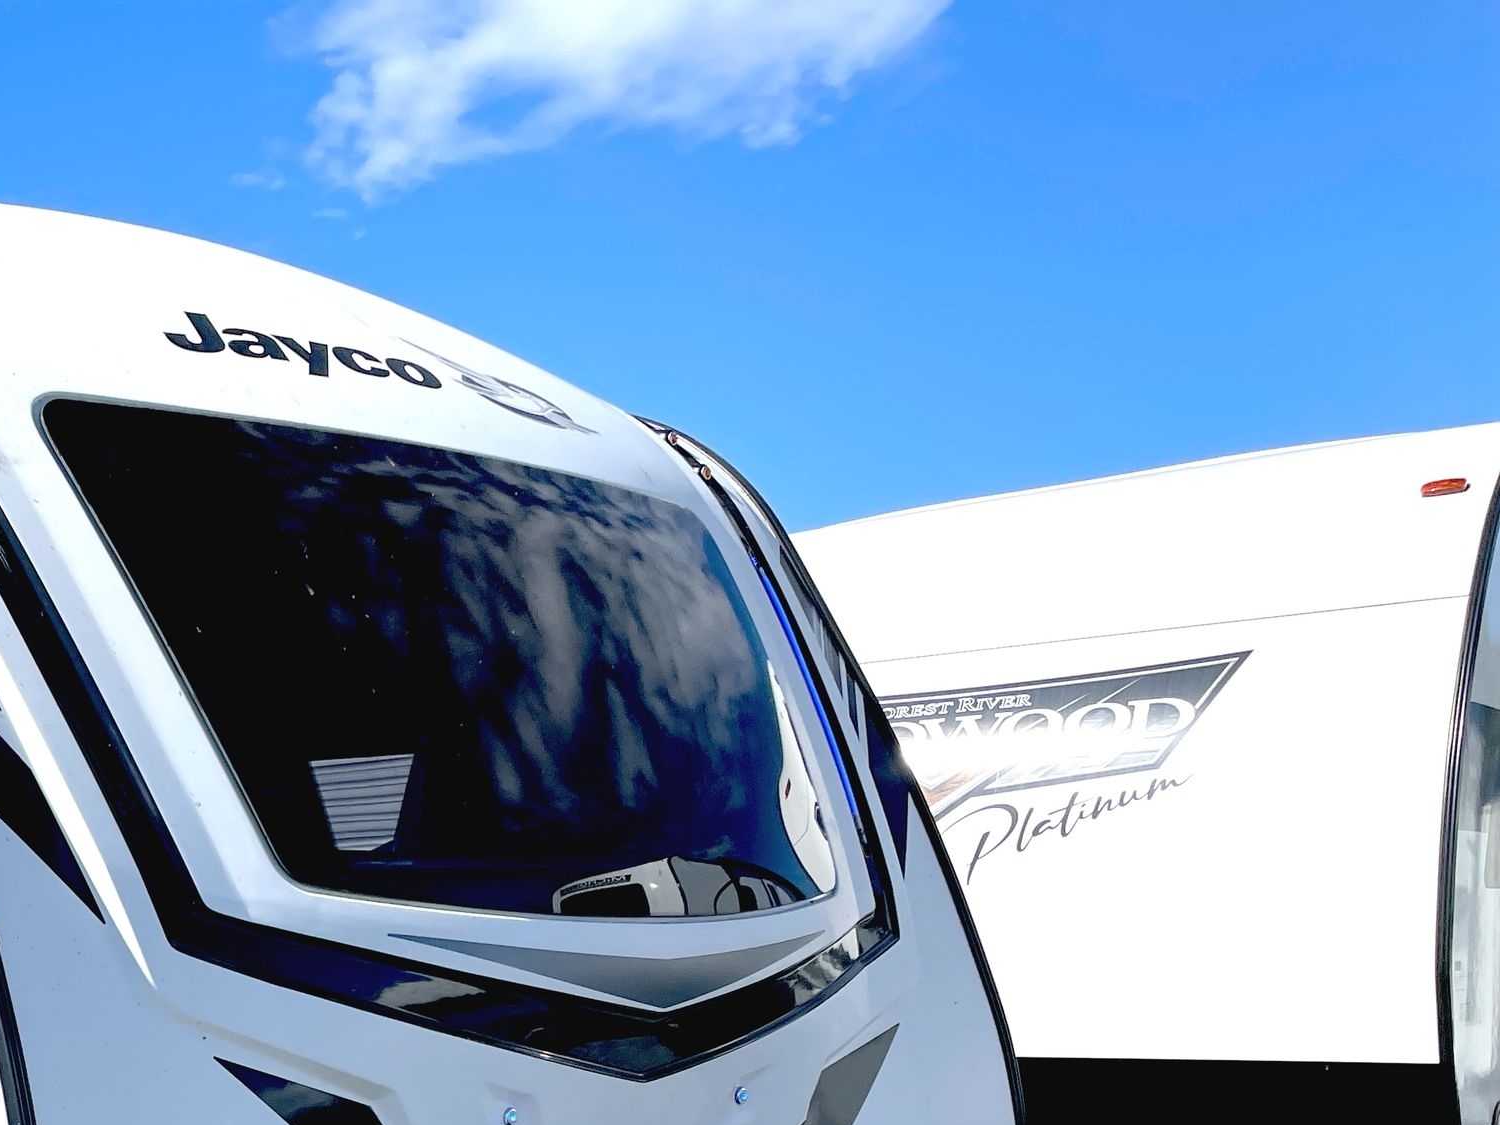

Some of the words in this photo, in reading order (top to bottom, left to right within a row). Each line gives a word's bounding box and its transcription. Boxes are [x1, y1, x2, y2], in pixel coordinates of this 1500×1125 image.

[162, 310, 443, 390] Jayco
[882, 700, 954, 720] OREST
[956, 693, 1033, 713] RIVER
[942, 773, 1193, 885] Platinum
